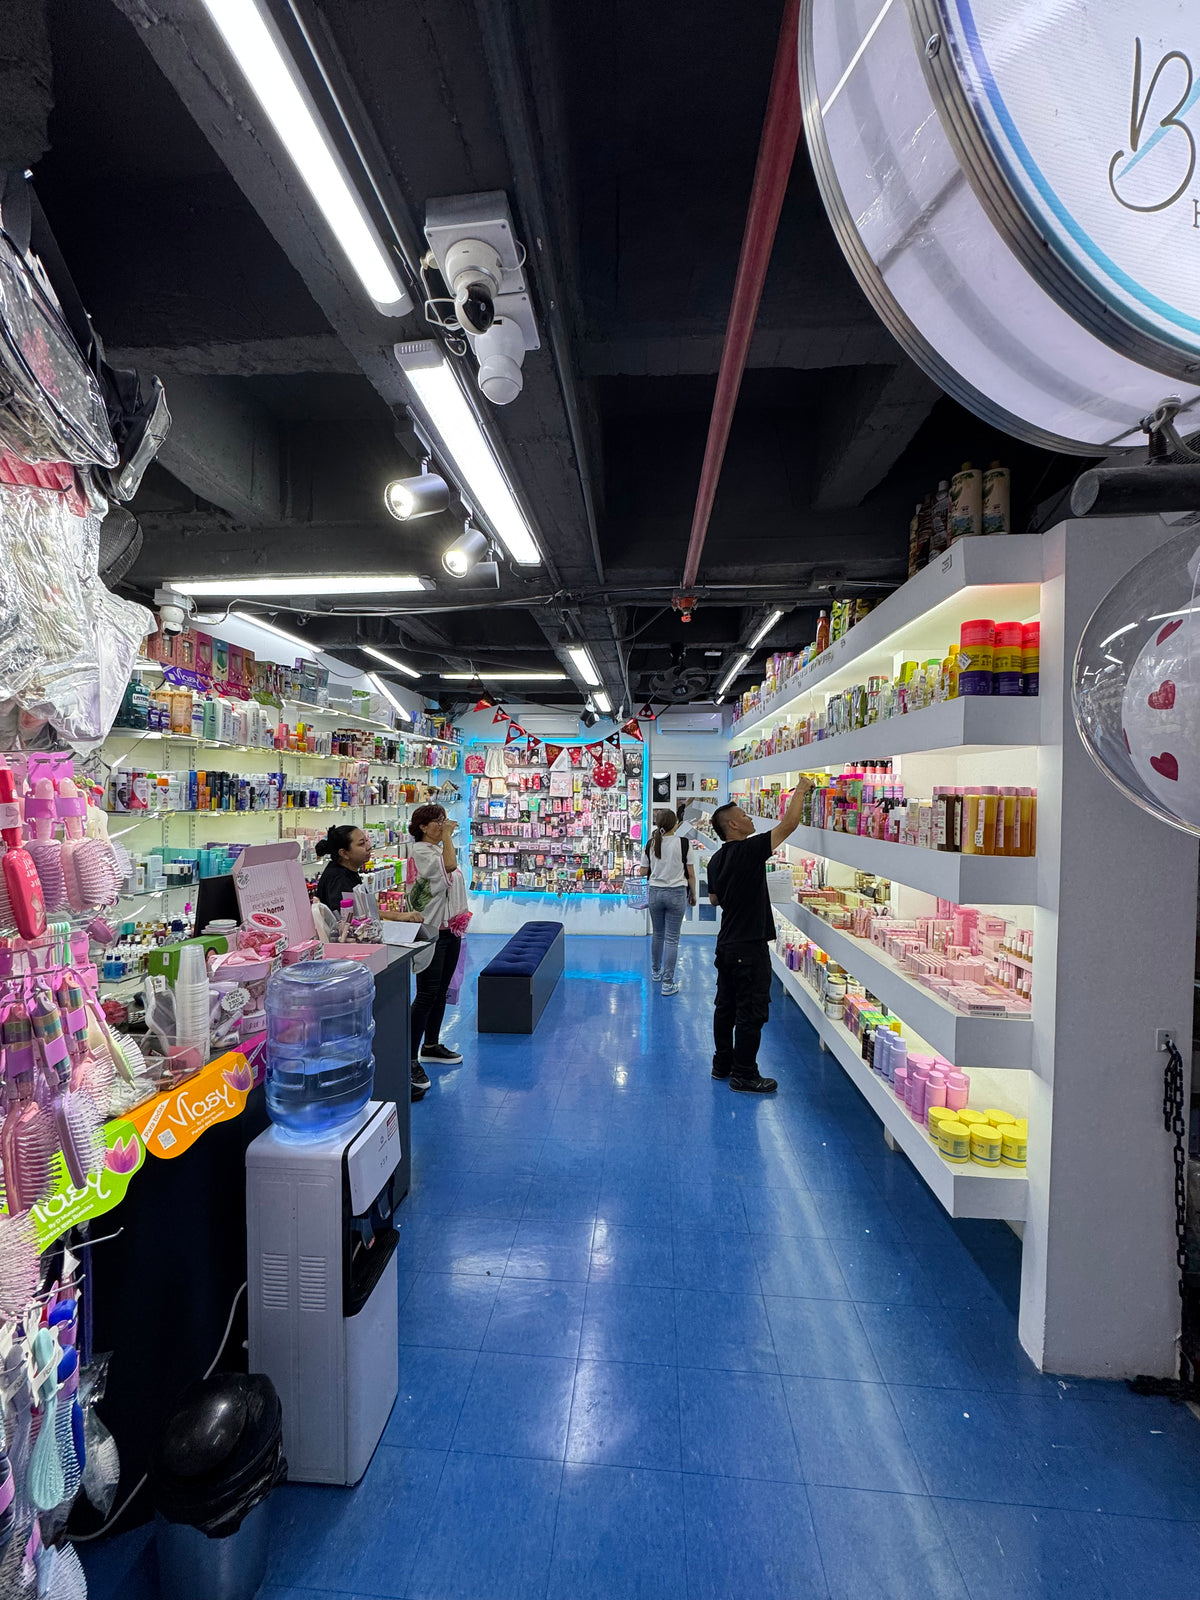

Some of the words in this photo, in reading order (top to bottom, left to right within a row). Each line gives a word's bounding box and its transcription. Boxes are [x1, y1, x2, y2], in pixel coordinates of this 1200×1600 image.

[143, 1121, 157, 1138] Para
[153, 1104, 166, 1122] todas
[168, 1083, 236, 1127] Vlasy
